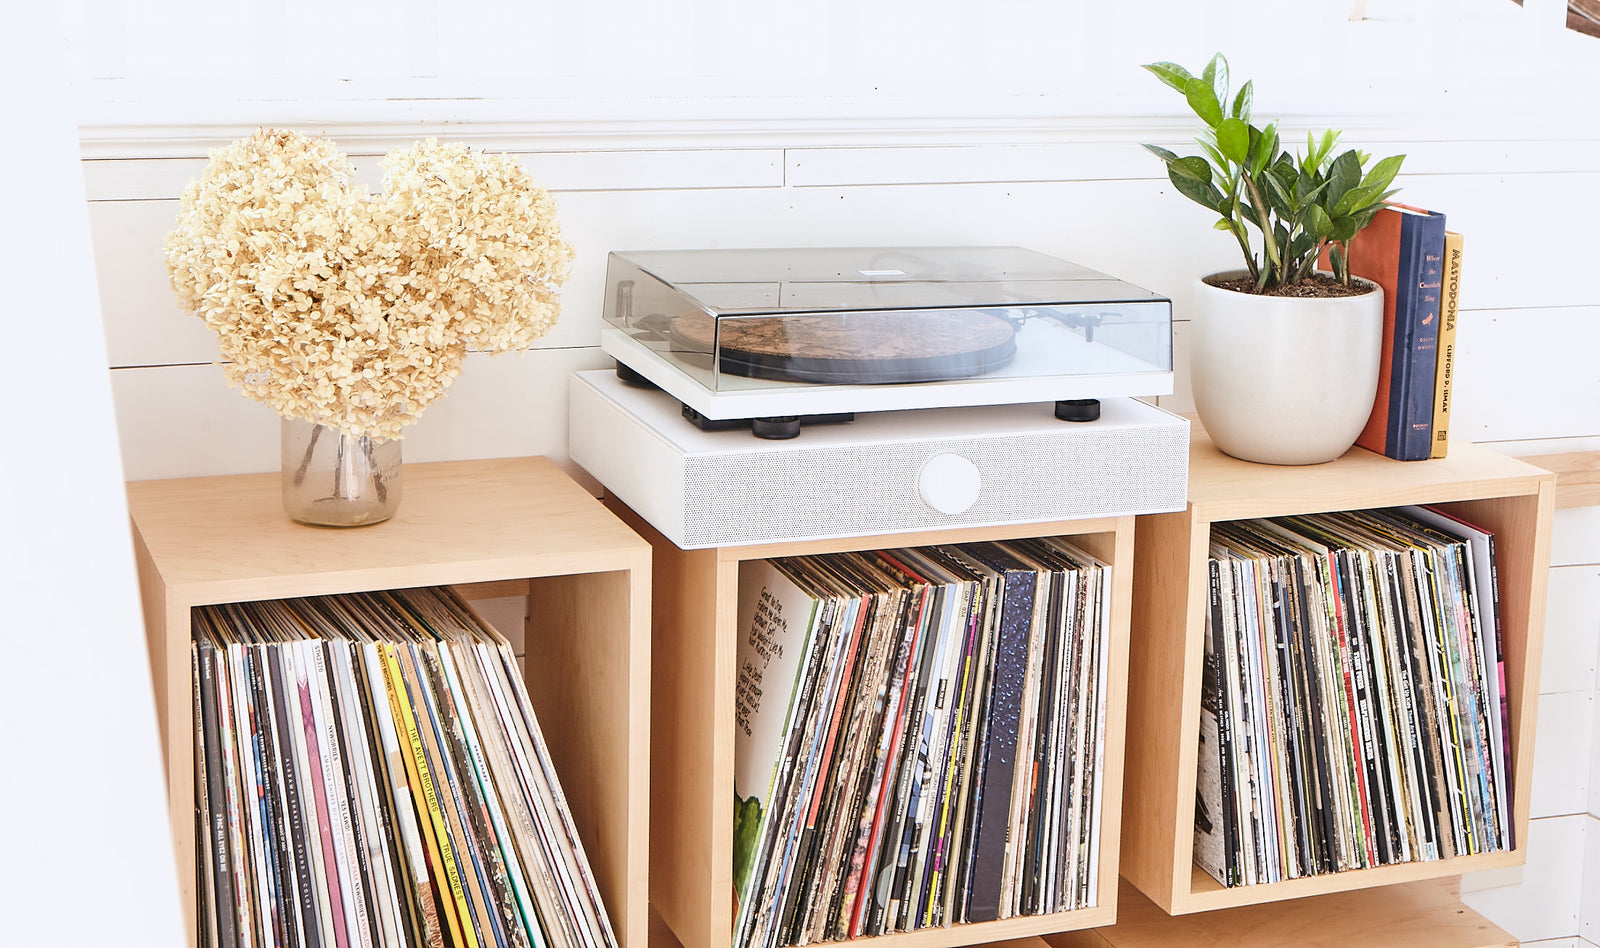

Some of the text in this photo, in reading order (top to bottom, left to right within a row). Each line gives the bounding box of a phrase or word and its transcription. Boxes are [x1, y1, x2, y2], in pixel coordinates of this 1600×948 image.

[1446, 248, 1460, 332] MASTODONIA
[1442, 390, 1450, 413] SIMAK
[382, 667, 392, 691] BROTHERS
[314, 645, 323, 672] STH2370
[327, 724, 338, 761] NXWORRIES
[354, 882, 365, 917] NXWORRIES
[322, 754, 332, 781] AMANDA
[409, 727, 418, 743] THE
[414, 746, 426, 770] AVETT
[421, 772, 438, 812] BROTHERS
[441, 843, 452, 863] TRUE
[448, 866, 463, 900] SADNESS
[926, 791, 935, 819] OFFERING
[284, 757, 294, 795] ALABAMA
[290, 798, 299, 829] SHAKES
[297, 844, 305, 870] SOUND
[302, 882, 311, 909] COLOR
[219, 854, 225, 863] ON
[220, 863, 225, 872] ME
